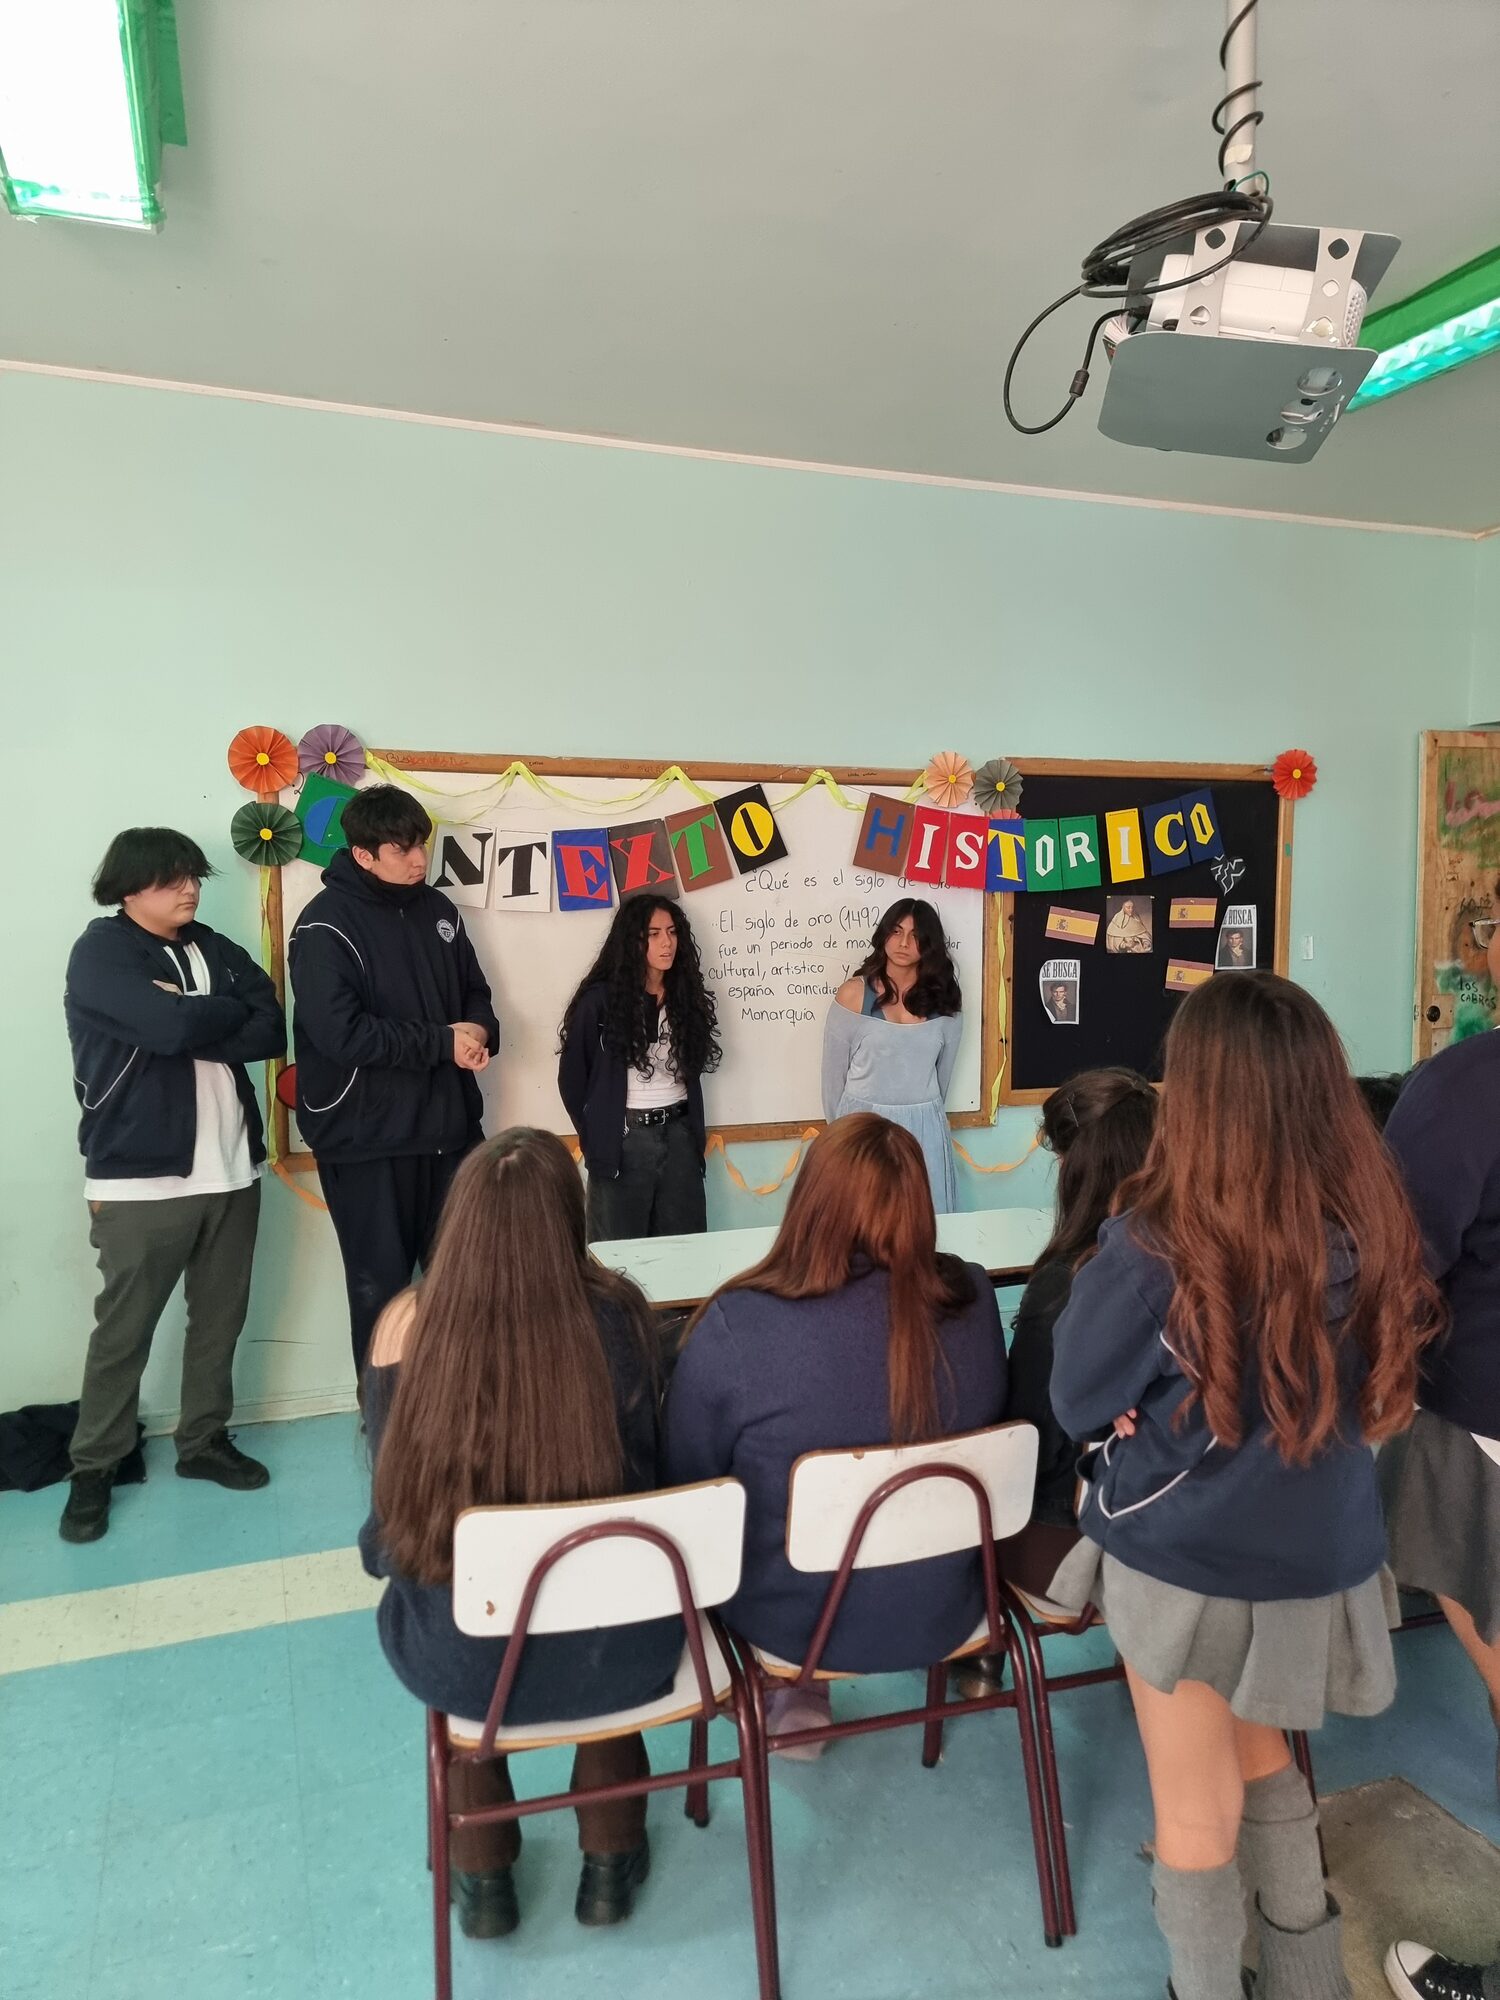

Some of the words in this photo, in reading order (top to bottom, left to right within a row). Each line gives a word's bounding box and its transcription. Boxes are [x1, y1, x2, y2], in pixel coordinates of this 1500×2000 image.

[304, 795, 774, 902] CNTEXTO
[865, 802, 1215, 882] HISTORICO
[803, 875, 818, 888] es
[833, 868, 844, 887] el
[855, 870, 885, 894] siglo
[719, 909, 734, 933] El
[745, 909, 776, 940] siglo
[784, 909, 799, 928] de
[807, 913, 833, 927] oro
[1228, 909, 1253, 925] BUSCA
[718, 943, 738, 959] fue
[746, 943, 761, 955] un
[770, 935, 814, 957] periodo
[823, 934, 838, 949] de
[708, 960, 767, 981] cultural,
[841, 964, 850, 983] y
[1042, 962, 1051, 978] SE
[1053, 961, 1078, 978] BUSCA
[728, 984, 775, 1002] españa
[787, 981, 838, 996] coincidie
